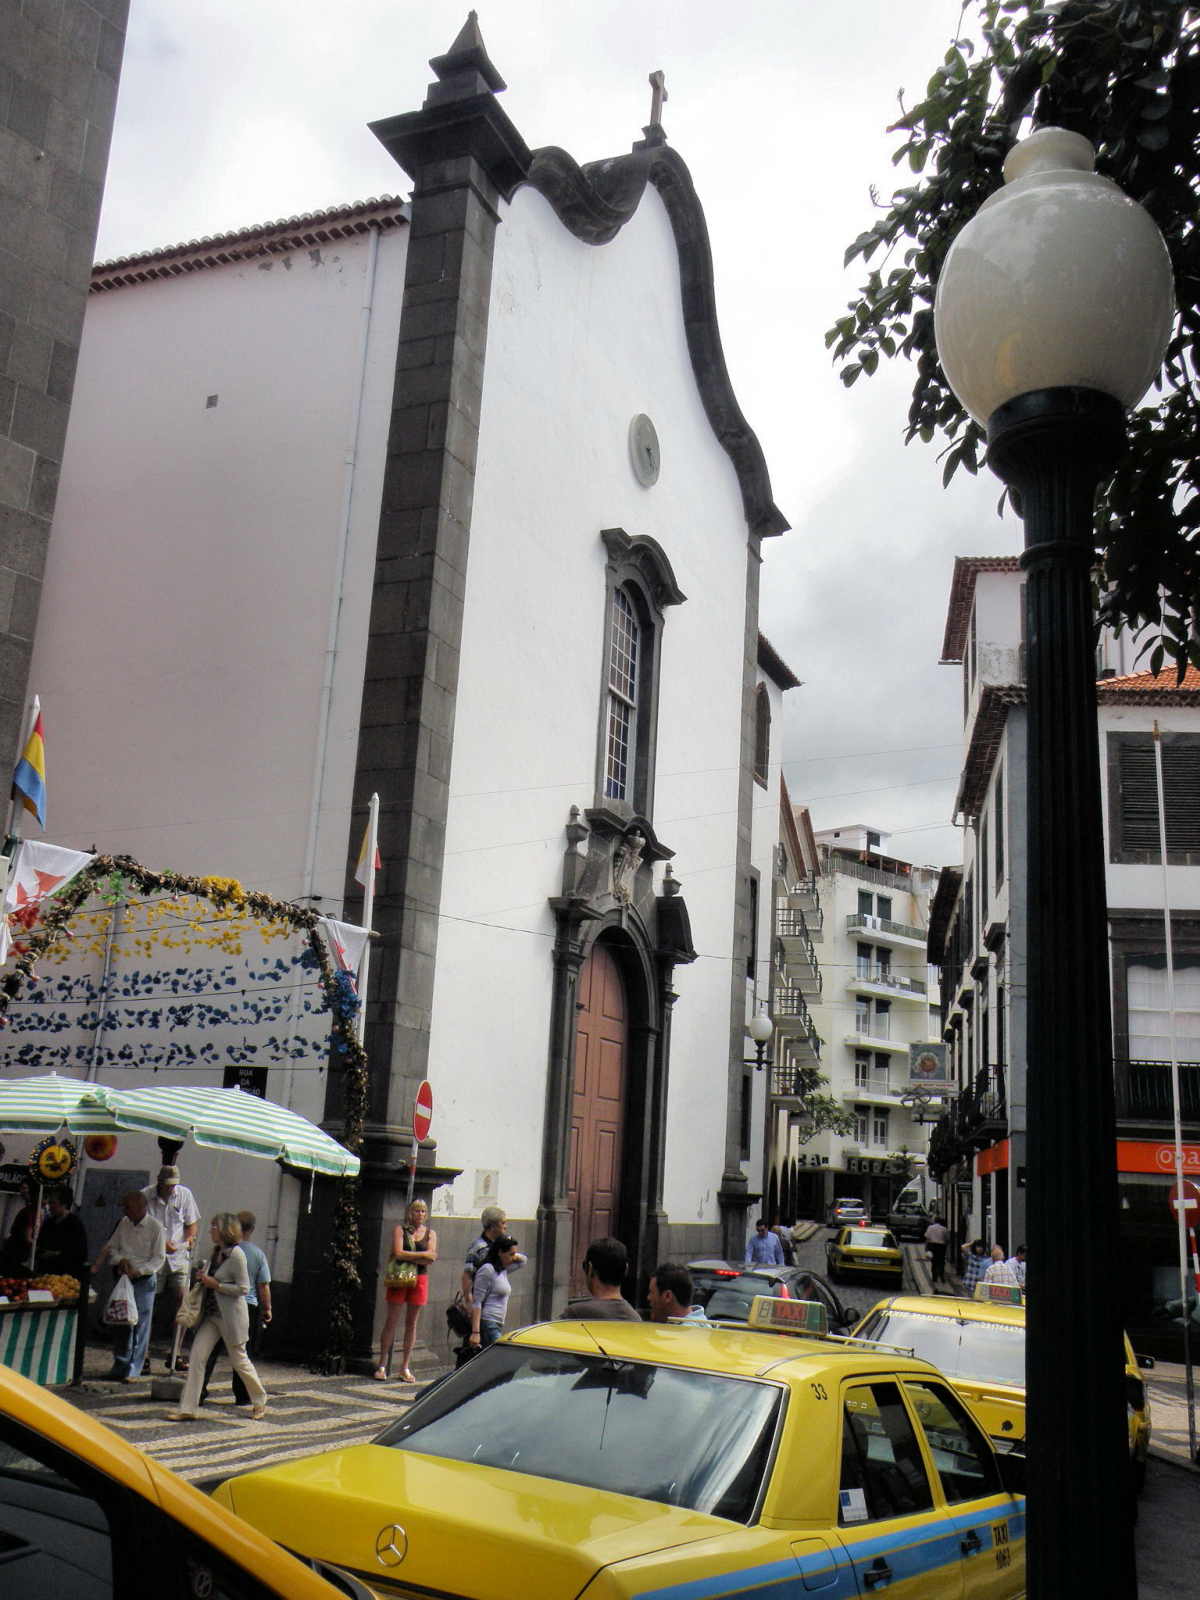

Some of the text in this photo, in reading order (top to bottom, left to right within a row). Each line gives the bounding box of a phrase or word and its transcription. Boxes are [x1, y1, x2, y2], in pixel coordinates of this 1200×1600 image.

[775, 1302, 806, 1320] TAXI
[811, 1384, 827, 1400] 33
[993, 1523, 1008, 1546] TAXI
